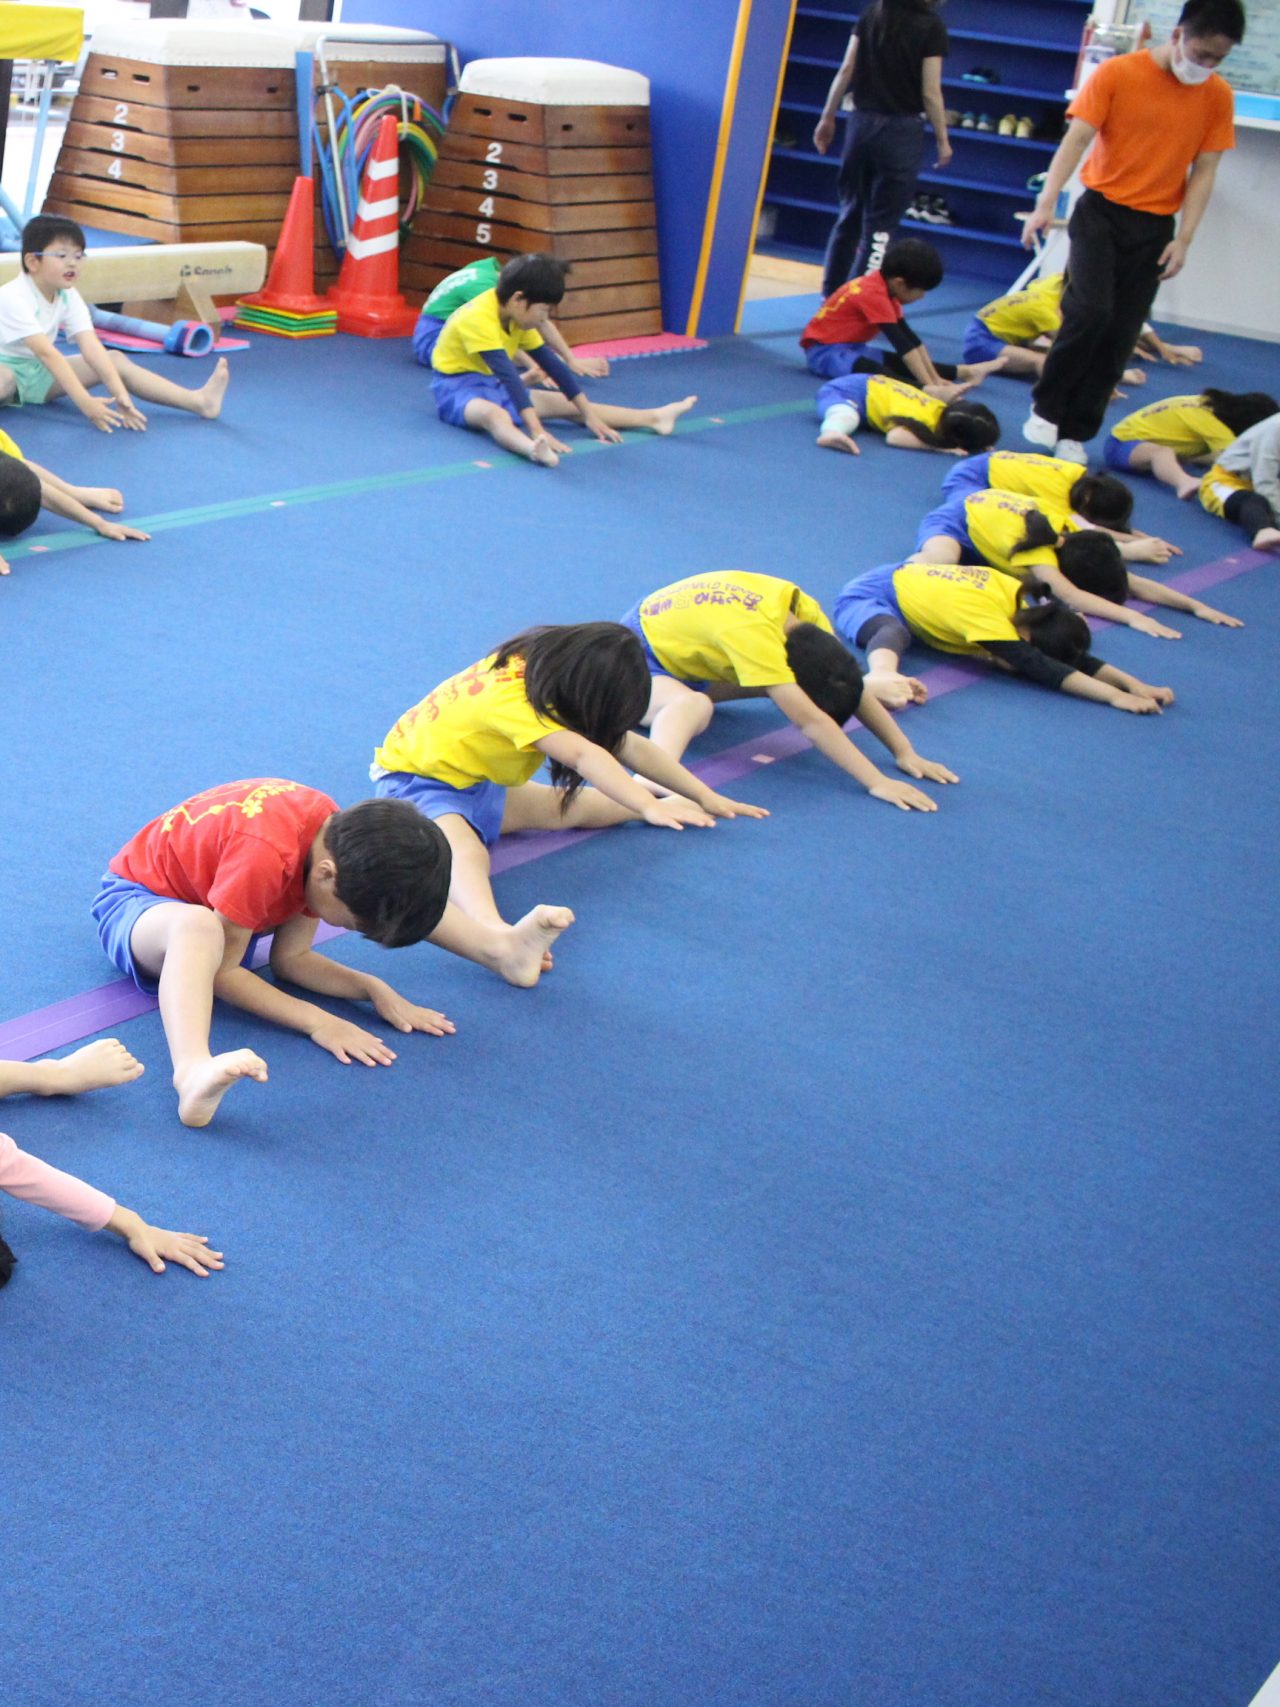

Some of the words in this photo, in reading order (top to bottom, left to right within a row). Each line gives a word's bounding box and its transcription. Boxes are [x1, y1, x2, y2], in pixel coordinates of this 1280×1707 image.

[113, 104, 129, 125] 2
[111, 131, 125, 152] 3
[485, 142, 503, 164] 2
[107, 158, 122, 179] 4
[482, 169, 498, 190] 3
[478, 197, 494, 218] 4
[475, 222, 491, 244] 5
